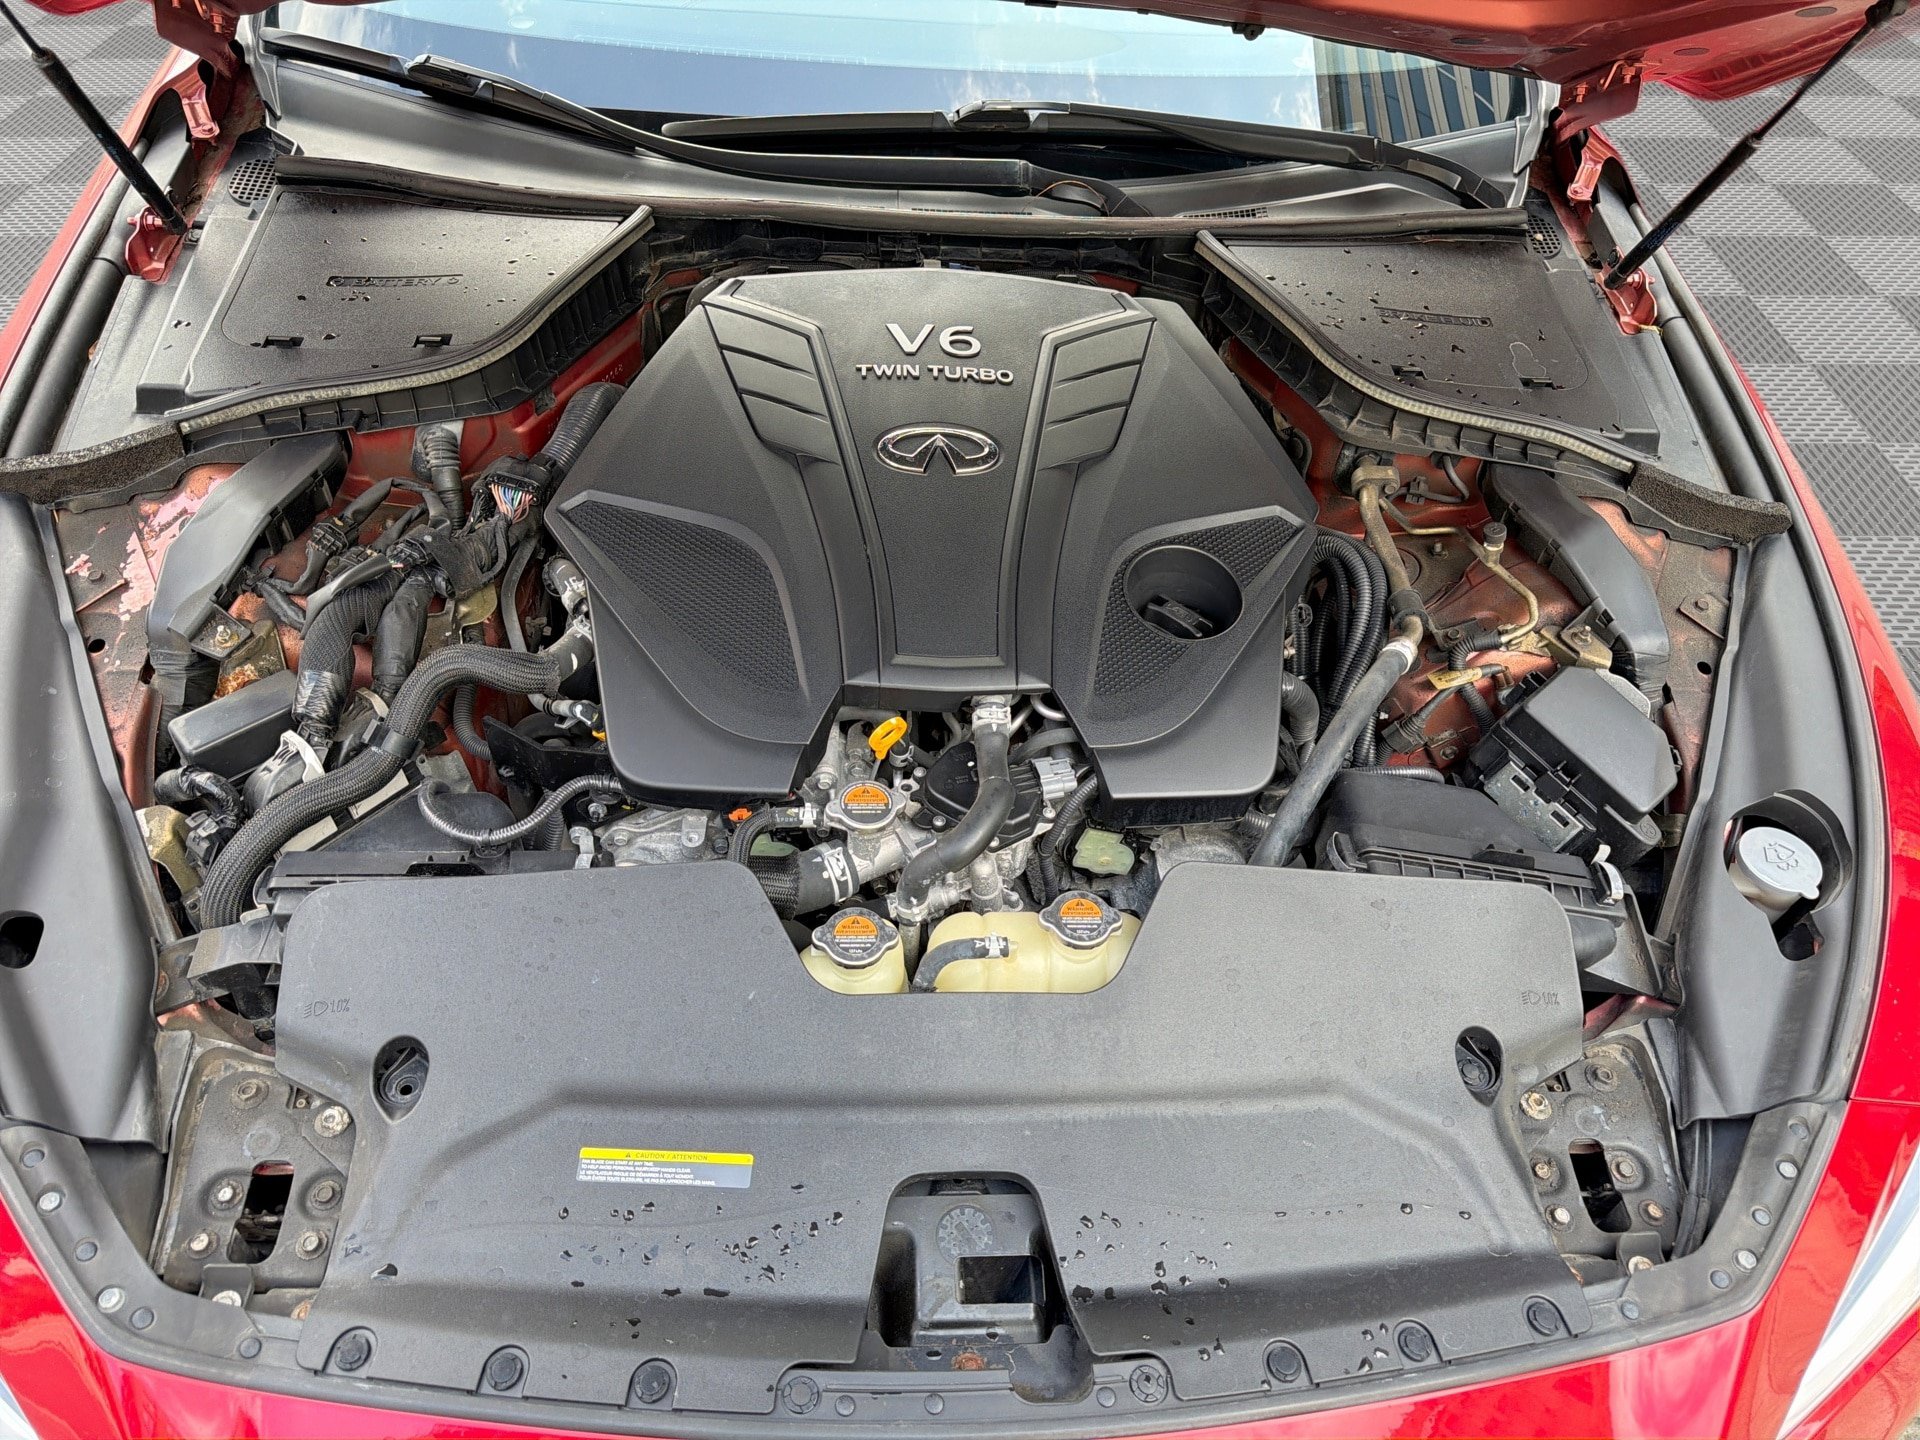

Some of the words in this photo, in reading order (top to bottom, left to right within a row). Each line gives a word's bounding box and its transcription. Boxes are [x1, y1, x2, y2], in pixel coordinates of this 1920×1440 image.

[352, 277, 442, 287] BATTERY
[885, 323, 982, 357] V6
[856, 364, 920, 380] TWIN
[928, 365, 1014, 384] TURBO
